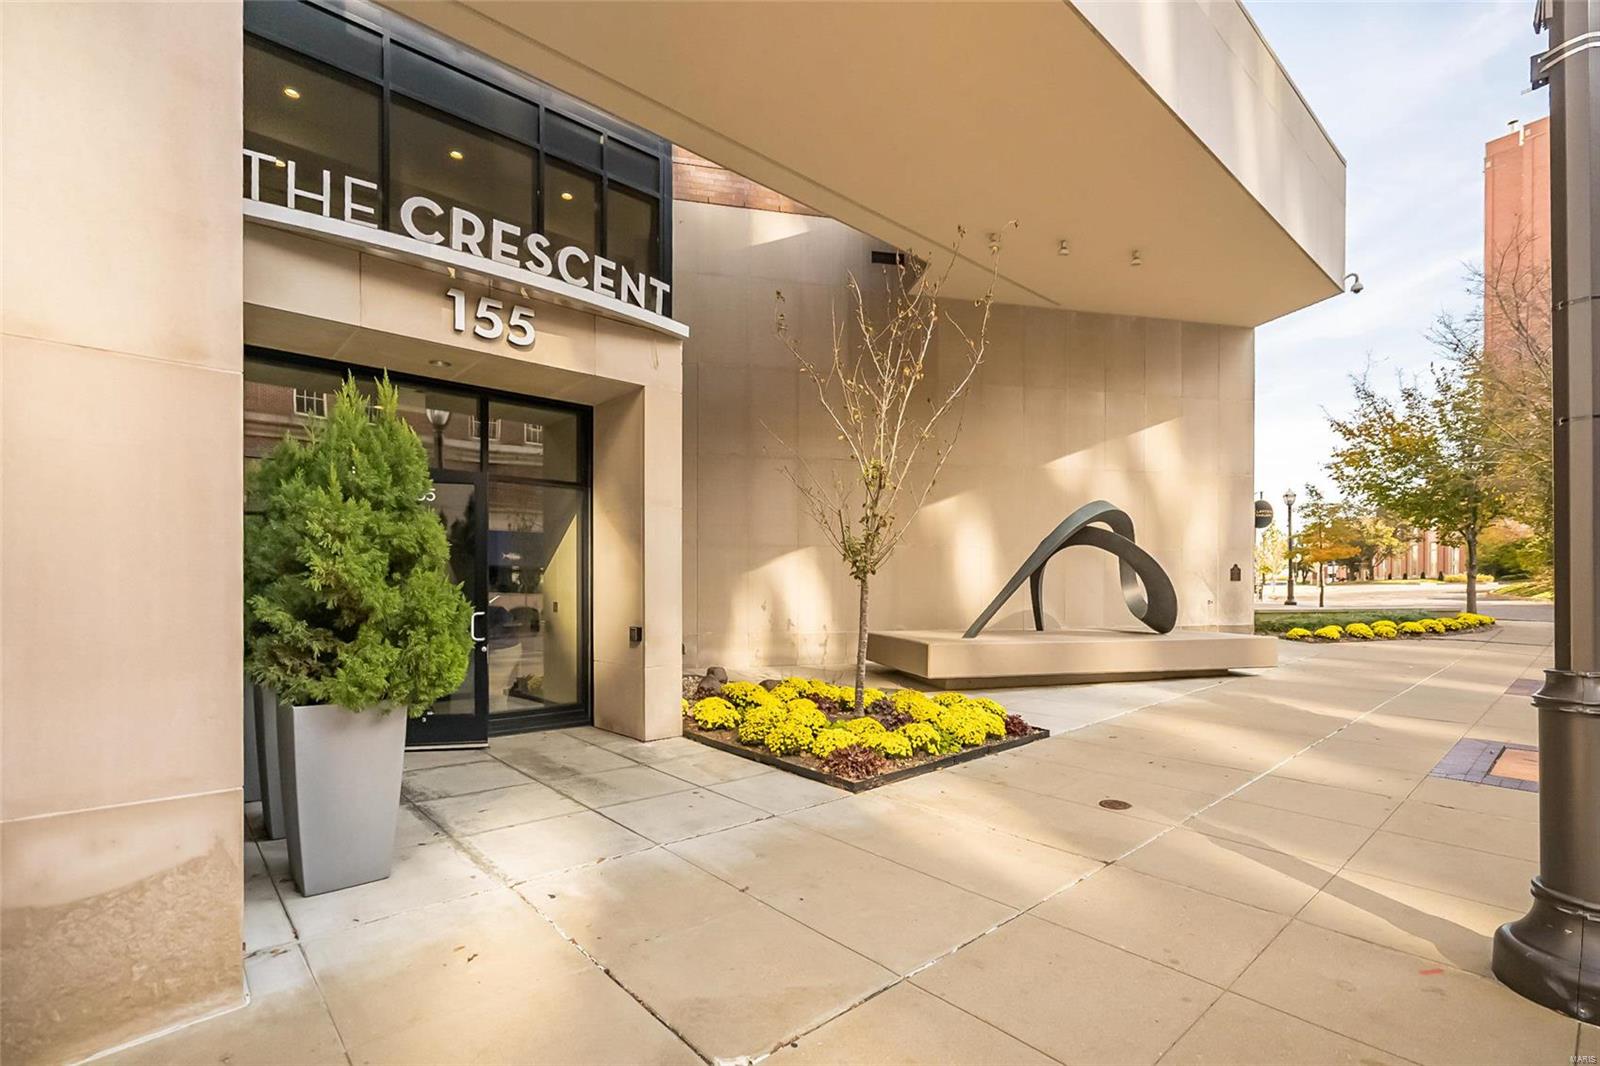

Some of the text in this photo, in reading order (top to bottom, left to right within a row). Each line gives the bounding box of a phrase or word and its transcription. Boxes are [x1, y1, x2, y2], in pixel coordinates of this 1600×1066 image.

[243, 148, 671, 317] THE CRESCENT
[445, 287, 536, 347] 155
